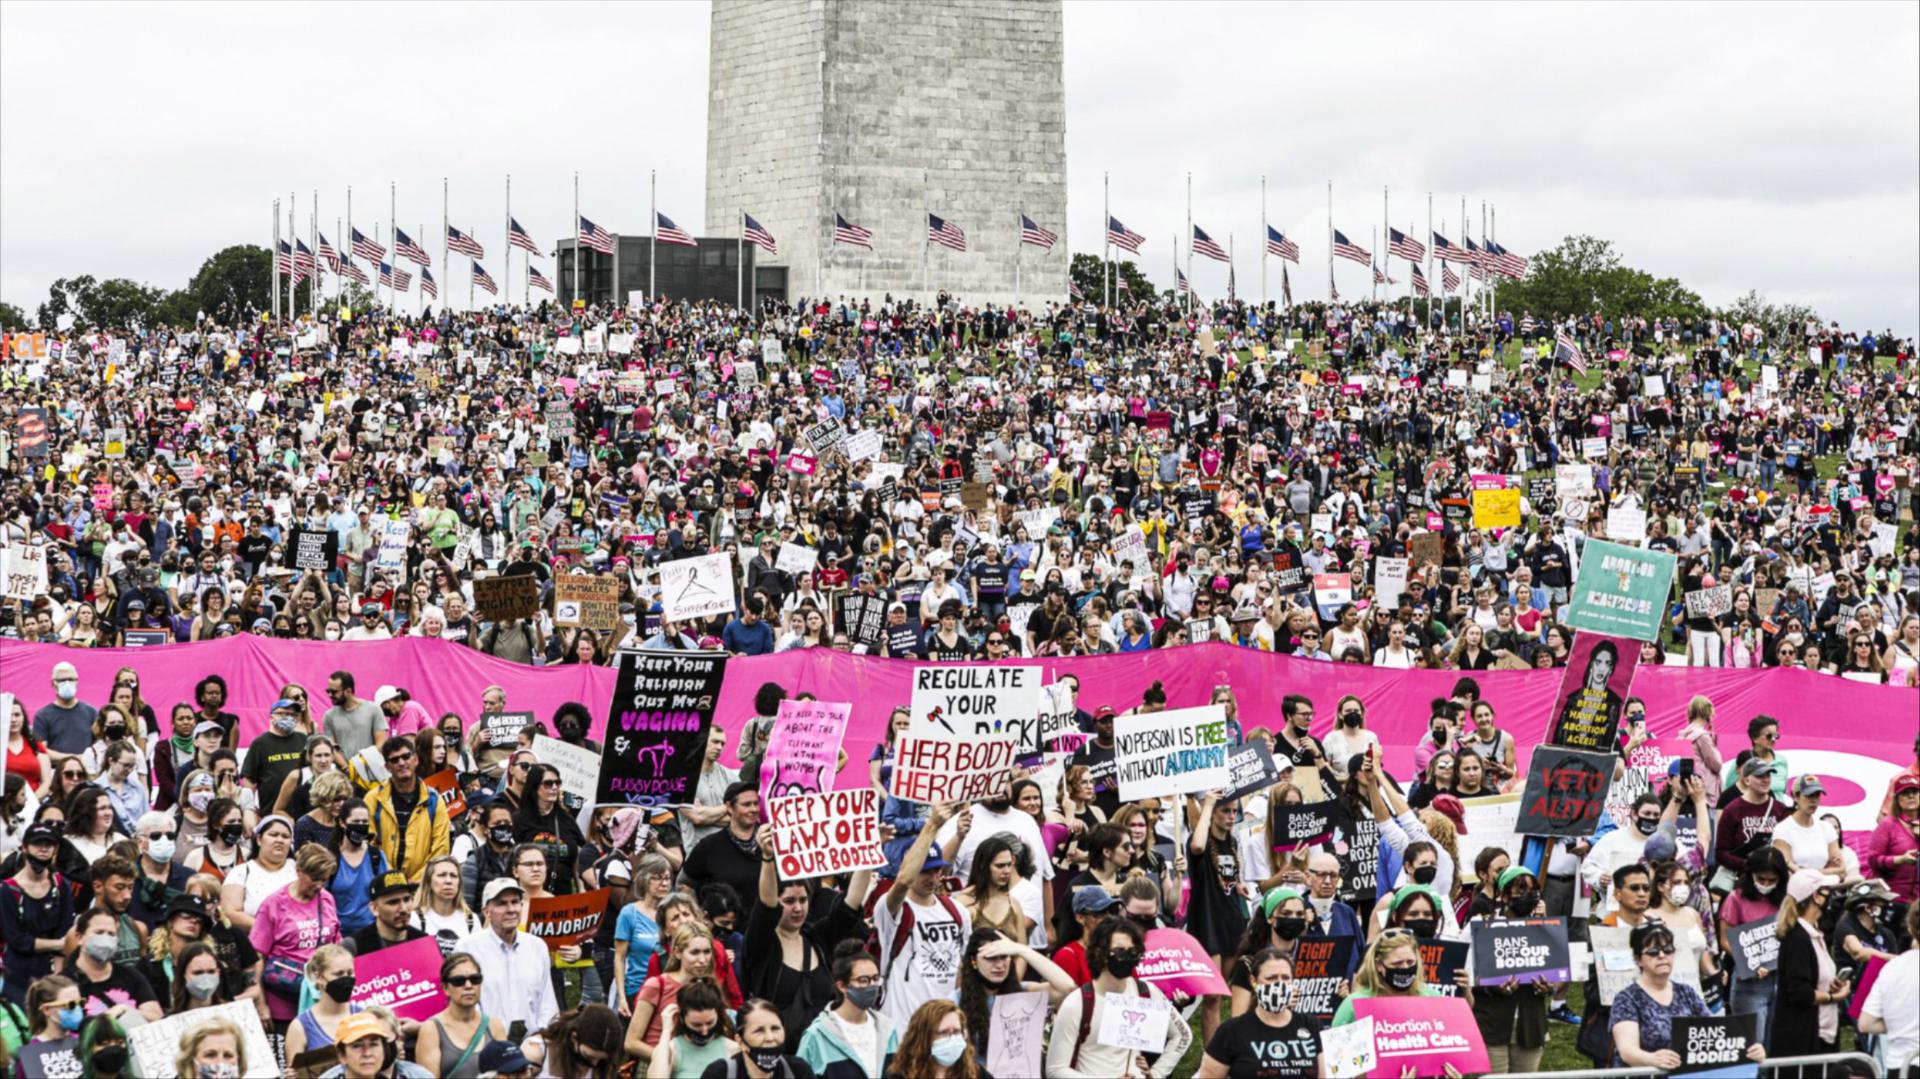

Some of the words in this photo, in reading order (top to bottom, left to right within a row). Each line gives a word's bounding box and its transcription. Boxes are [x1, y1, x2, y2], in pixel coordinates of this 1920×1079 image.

[299, 543, 321, 551] WITH
[300, 534, 327, 542] STAND
[1602, 554, 1656, 577] ABORTION
[1621, 573, 1633, 591] IS
[866, 597, 885, 612] HOW
[1587, 589, 1652, 614] HEALTHCARE
[845, 610, 860, 624] DAR
[862, 610, 883, 628] DARE
[634, 655, 671, 674] KEEP
[672, 655, 714, 674] YOUR
[634, 676, 705, 698] RELIGION
[918, 667, 1025, 690] REGULATE
[634, 694, 666, 710] OUT
[673, 694, 697, 709] MY
[946, 694, 997, 714] YOUR
[621, 711, 702, 733] VAGINA
[1040, 711, 1076, 734] Barre
[1595, 713, 1607, 723] MY
[785, 723, 815, 736] ABOUT
[819, 724, 835, 735] THE
[1563, 722, 1608, 736] ABORTION
[614, 734, 631, 756] &
[1114, 736, 1132, 757] NO
[1132, 731, 1175, 752] PERSON
[1178, 728, 1193, 746] IS
[1195, 722, 1227, 747] FREE
[899, 738, 949, 771] HER
[955, 741, 1017, 771] BODY
[1630, 755, 1653, 767] OFF
[1653, 755, 1680, 768] OU
[784, 761, 815, 774] WOMB
[1117, 756, 1166, 783] WITHOUT
[1162, 747, 1227, 776] AUTONOMY
[895, 770, 947, 800] HER
[948, 768, 1009, 801] CHOICE
[1542, 767, 1605, 794] VETO
[769, 795, 816, 831] KEEP
[818, 789, 877, 818] YOUR
[1530, 796, 1601, 822] ALITO
[1287, 822, 1308, 834] OFF
[1308, 816, 1327, 830] OUR
[1288, 813, 1315, 824] BANS
[773, 821, 829, 858] LAWS
[833, 815, 878, 846] OFF
[1288, 828, 1323, 839] BODIES
[1350, 832, 1380, 849] LAWS
[780, 850, 829, 878] OUR
[829, 841, 885, 873] BODIES
[1350, 845, 1378, 862] ROSA
[1358, 860, 1378, 875] OFF
[1351, 875, 1378, 891] OVA
[530, 912, 602, 936] MAJORITY
[917, 920, 957, 943] VOTE
[1298, 942, 1335, 961] FIGHT
[1493, 936, 1528, 949] BANS
[1140, 949, 1183, 965] bortion
[1183, 949, 1193, 959] is
[1419, 945, 1445, 965] GHT
[1493, 947, 1519, 961] OFF
[1519, 943, 1550, 958] OUR
[1135, 959, 1178, 975] Health
[1179, 958, 1212, 972] Care.
[1296, 960, 1329, 977] BACK.
[1495, 957, 1546, 971] BODIES
[356, 972, 399, 996] bortion
[400, 968, 412, 983] is
[1294, 977, 1343, 996] PROTECT
[356, 987, 396, 1006] ealth
[397, 978, 437, 998] Care.
[1294, 994, 1333, 1013] HOICE.
[1374, 1019, 1432, 1035] Abortion
[1434, 1017, 1445, 1031] is
[1687, 1026, 1727, 1041] BANS
[1249, 1039, 1317, 1060] VOTE
[1376, 1034, 1428, 1051] Health
[1430, 1032, 1469, 1047] Care.
[1686, 1039, 1715, 1053] OFF
[1714, 1036, 1747, 1052] OUR
[1271, 1058, 1289, 1067] TELL
[1291, 1057, 1314, 1067] THEM
[1685, 1048, 1740, 1065] BODIES
[1280, 1067, 1302, 1077] SENT
